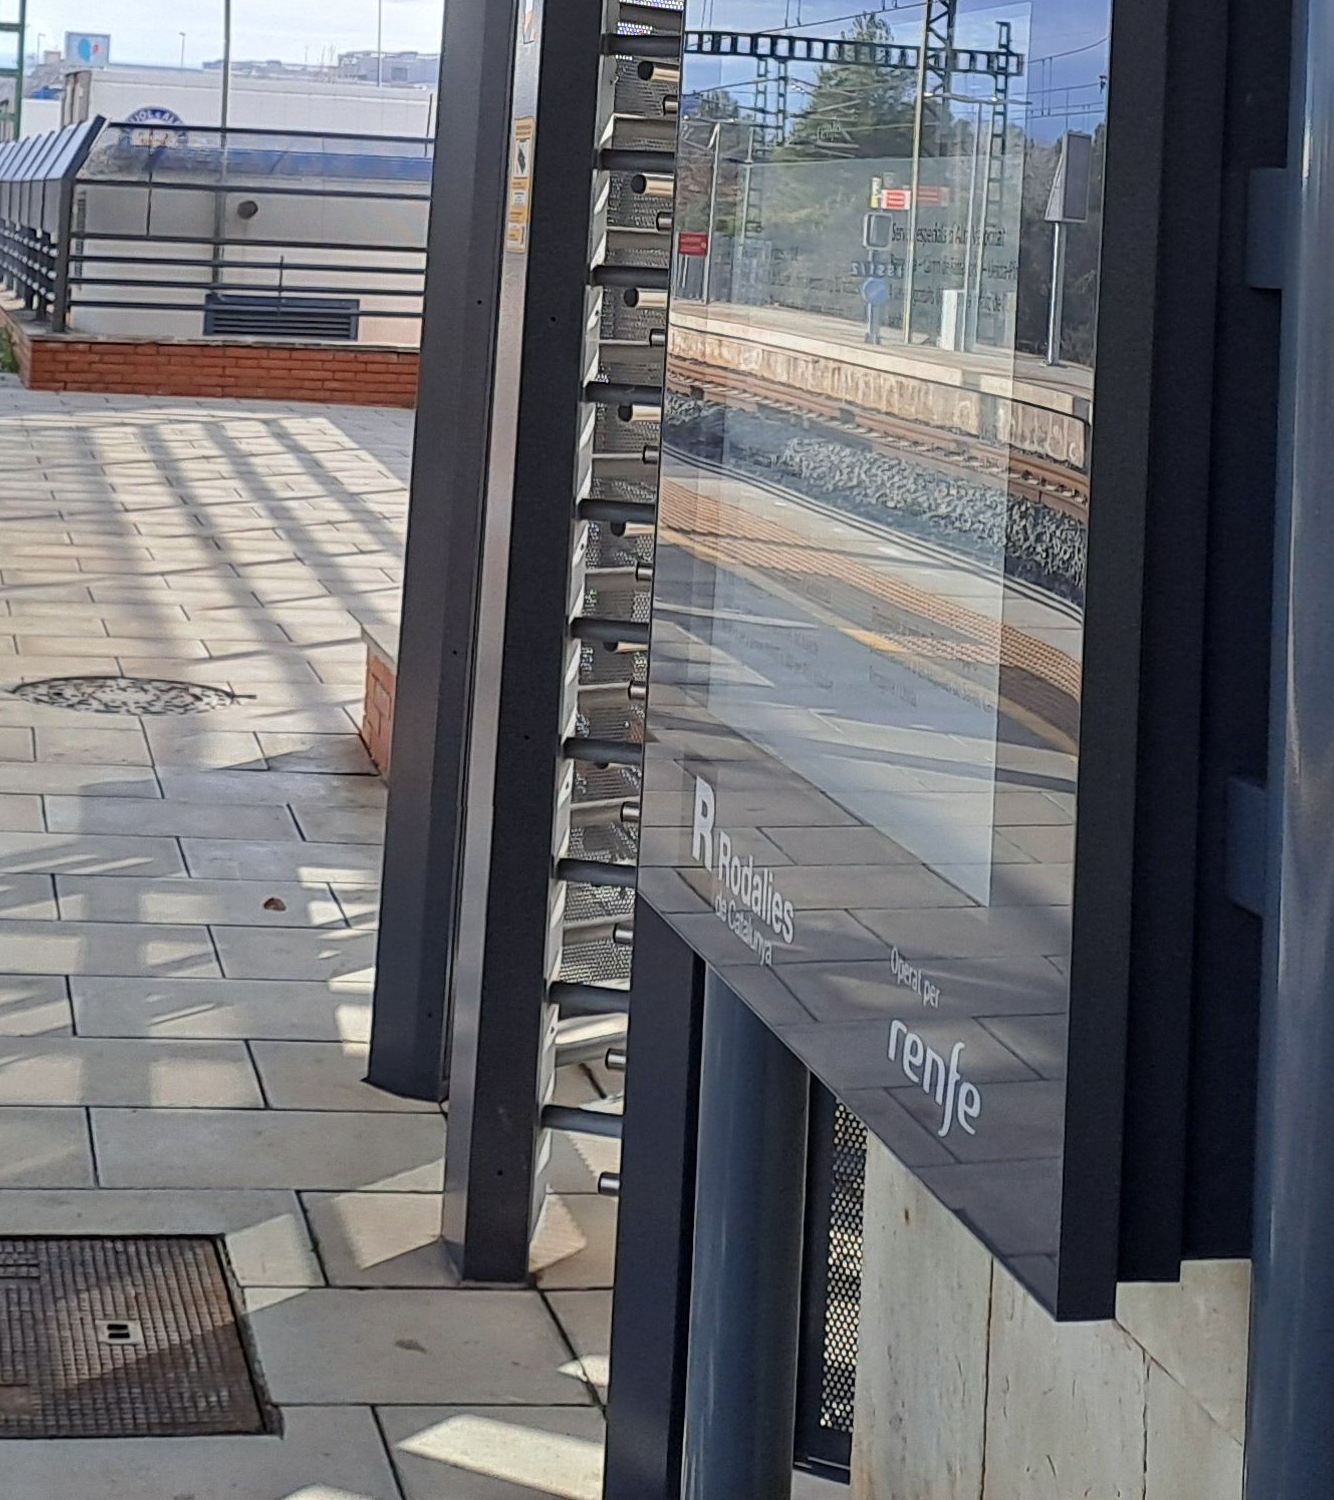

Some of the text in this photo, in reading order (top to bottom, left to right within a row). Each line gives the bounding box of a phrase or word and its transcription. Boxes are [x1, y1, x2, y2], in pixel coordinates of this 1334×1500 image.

[692, 775, 715, 872] R
[715, 891, 773, 967] de Catalunya
[718, 830, 795, 945] Rodalies
[890, 946, 942, 1009] Operat per
[887, 1019, 982, 1137] renfe
